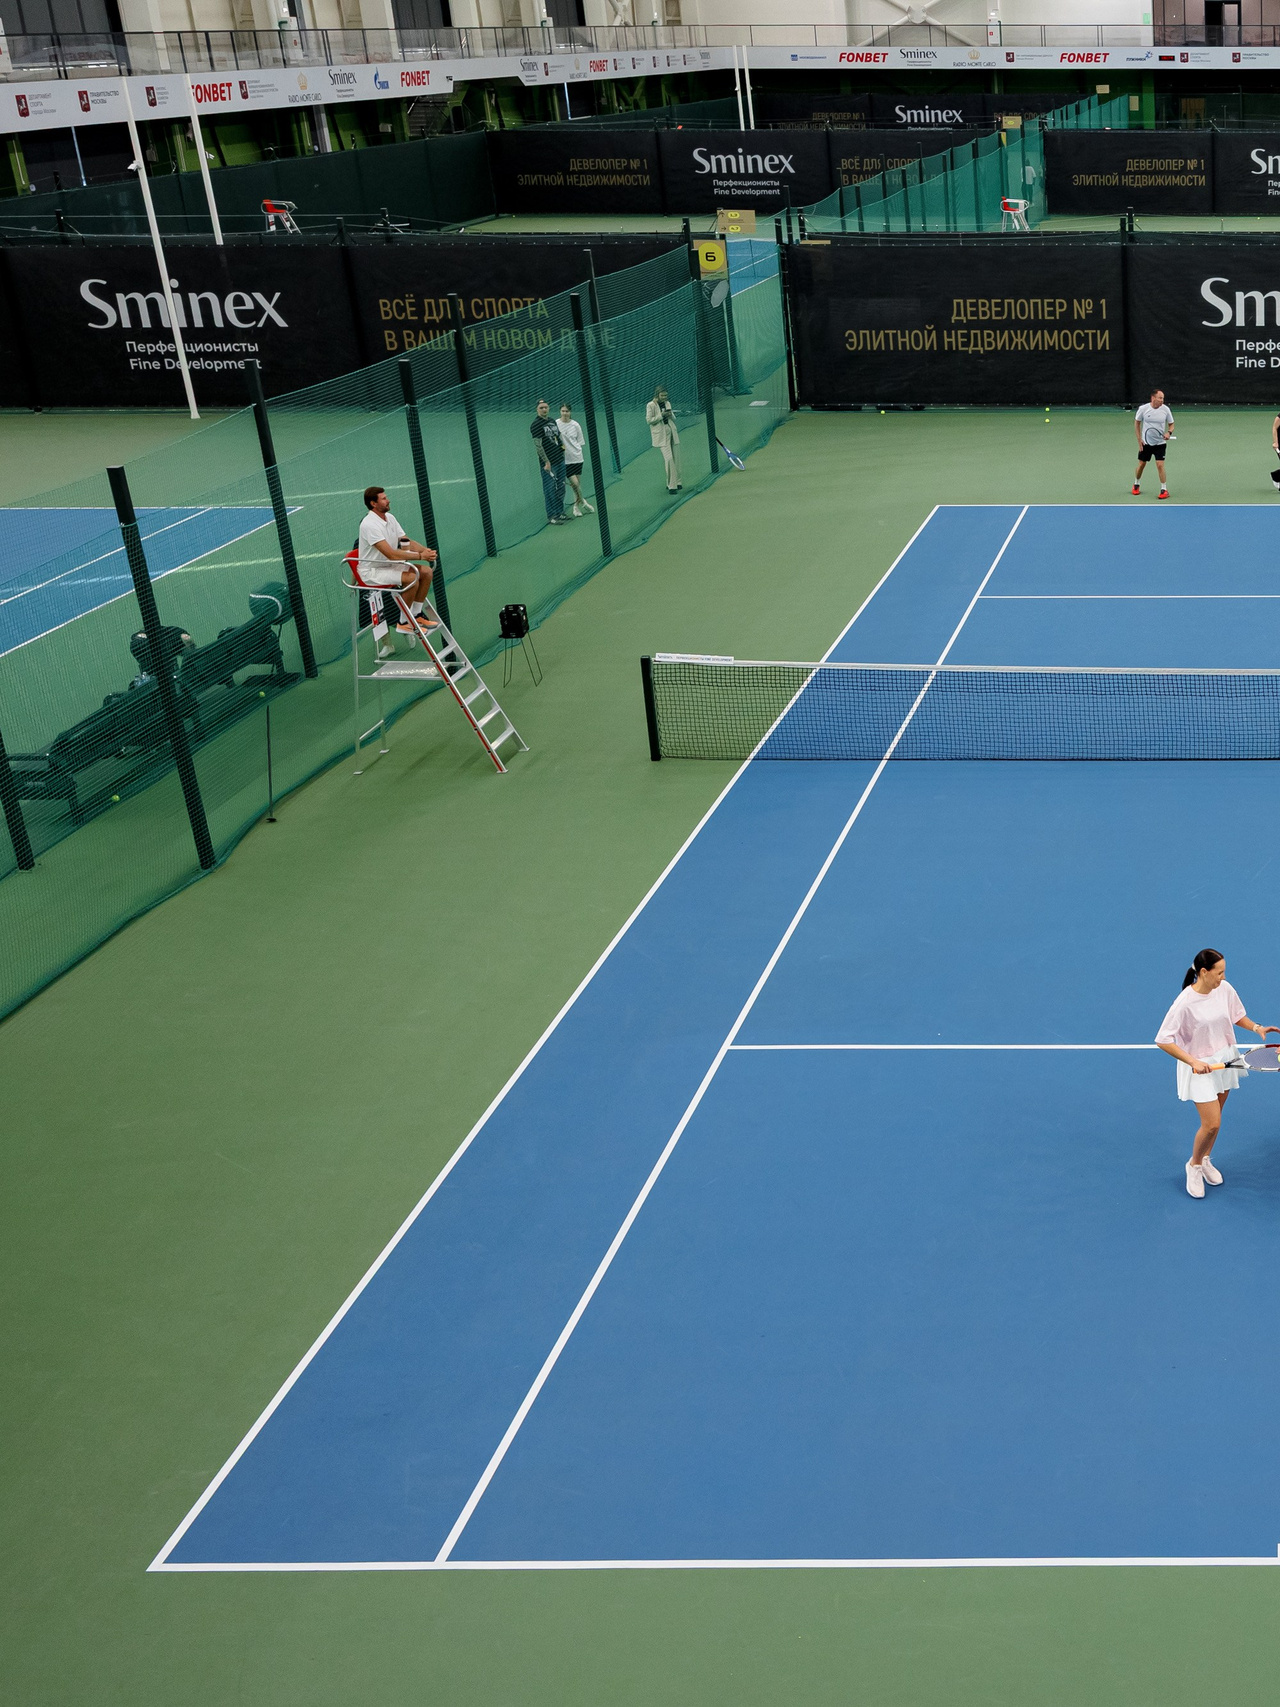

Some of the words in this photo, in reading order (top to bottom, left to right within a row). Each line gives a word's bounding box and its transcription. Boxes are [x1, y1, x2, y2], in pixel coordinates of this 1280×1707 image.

[838, 52, 889, 63] FONBET
[899, 48, 938, 59] Sminex
[1059, 52, 1110, 63] FONBET
[520, 58, 539, 72] Sminex
[589, 59, 609, 73] FONBET
[328, 69, 357, 86] Sminex
[401, 70, 430, 88] FONBET
[895, 105, 964, 123] Sminex
[569, 158, 627, 171] ДЕВЕЛОПЕР
[630, 158, 640, 170] №
[644, 158, 648, 170] 1
[692, 147, 796, 174] Sminex
[841, 156, 860, 169] ВСЁ
[1126, 159, 1185, 172] ДЕВЕЛОПЕР
[1187, 159, 1198, 171] №
[1200, 159, 1205, 171] 1
[517, 172, 565, 186] ЭЛИТНОЙ
[567, 174, 651, 187] НЕДВИЖИМОСТИ
[713, 179, 780, 188] Перфекционисты
[1072, 173, 1119, 186] ЭЛИТНОЙ
[1122, 174, 1206, 188] НЕДВИЖИМОСТИ
[731, 188, 780, 197] Development
[705, 251, 716, 262] 6
[80, 278, 289, 329] Sminex
[378, 294, 418, 321] ВСЁ
[471, 298, 550, 320] СПОРТА
[951, 299, 1067, 324] ДЕВЕЛОПЕР
[1073, 299, 1094, 320] №
[1100, 299, 1107, 320] 1
[384, 330, 398, 351] В
[483, 329, 551, 351] НОВОМ
[845, 325, 938, 351] ЭЛИТНОЙ
[944, 329, 1110, 354] НЕДВИЖИМОСТИ
[125, 340, 259, 355] Перфеционисты
[129, 358, 161, 370] Fine
[1236, 356, 1266, 368] Fine
